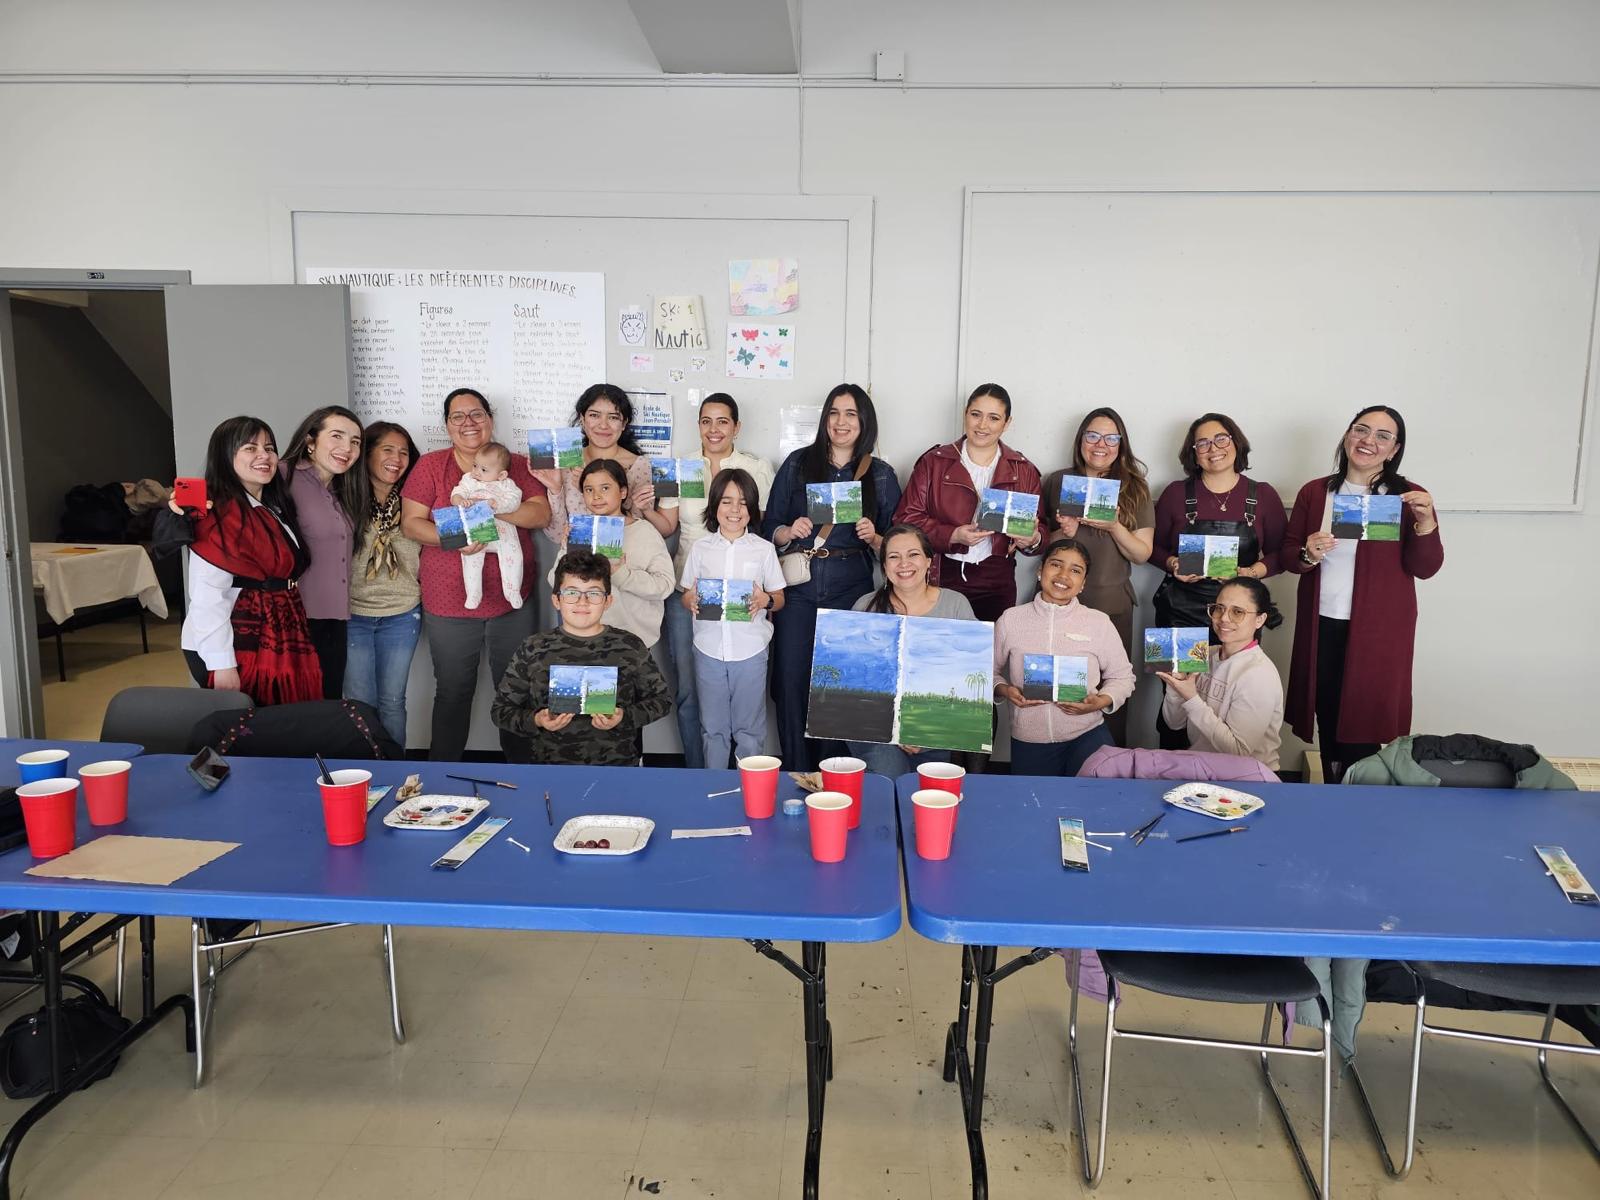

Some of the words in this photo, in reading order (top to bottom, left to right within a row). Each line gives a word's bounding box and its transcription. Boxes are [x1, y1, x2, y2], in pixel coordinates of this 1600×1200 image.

[405, 273, 425, 287] LES
[420, 302, 453, 320] Figures
[513, 303, 541, 318] Saut
